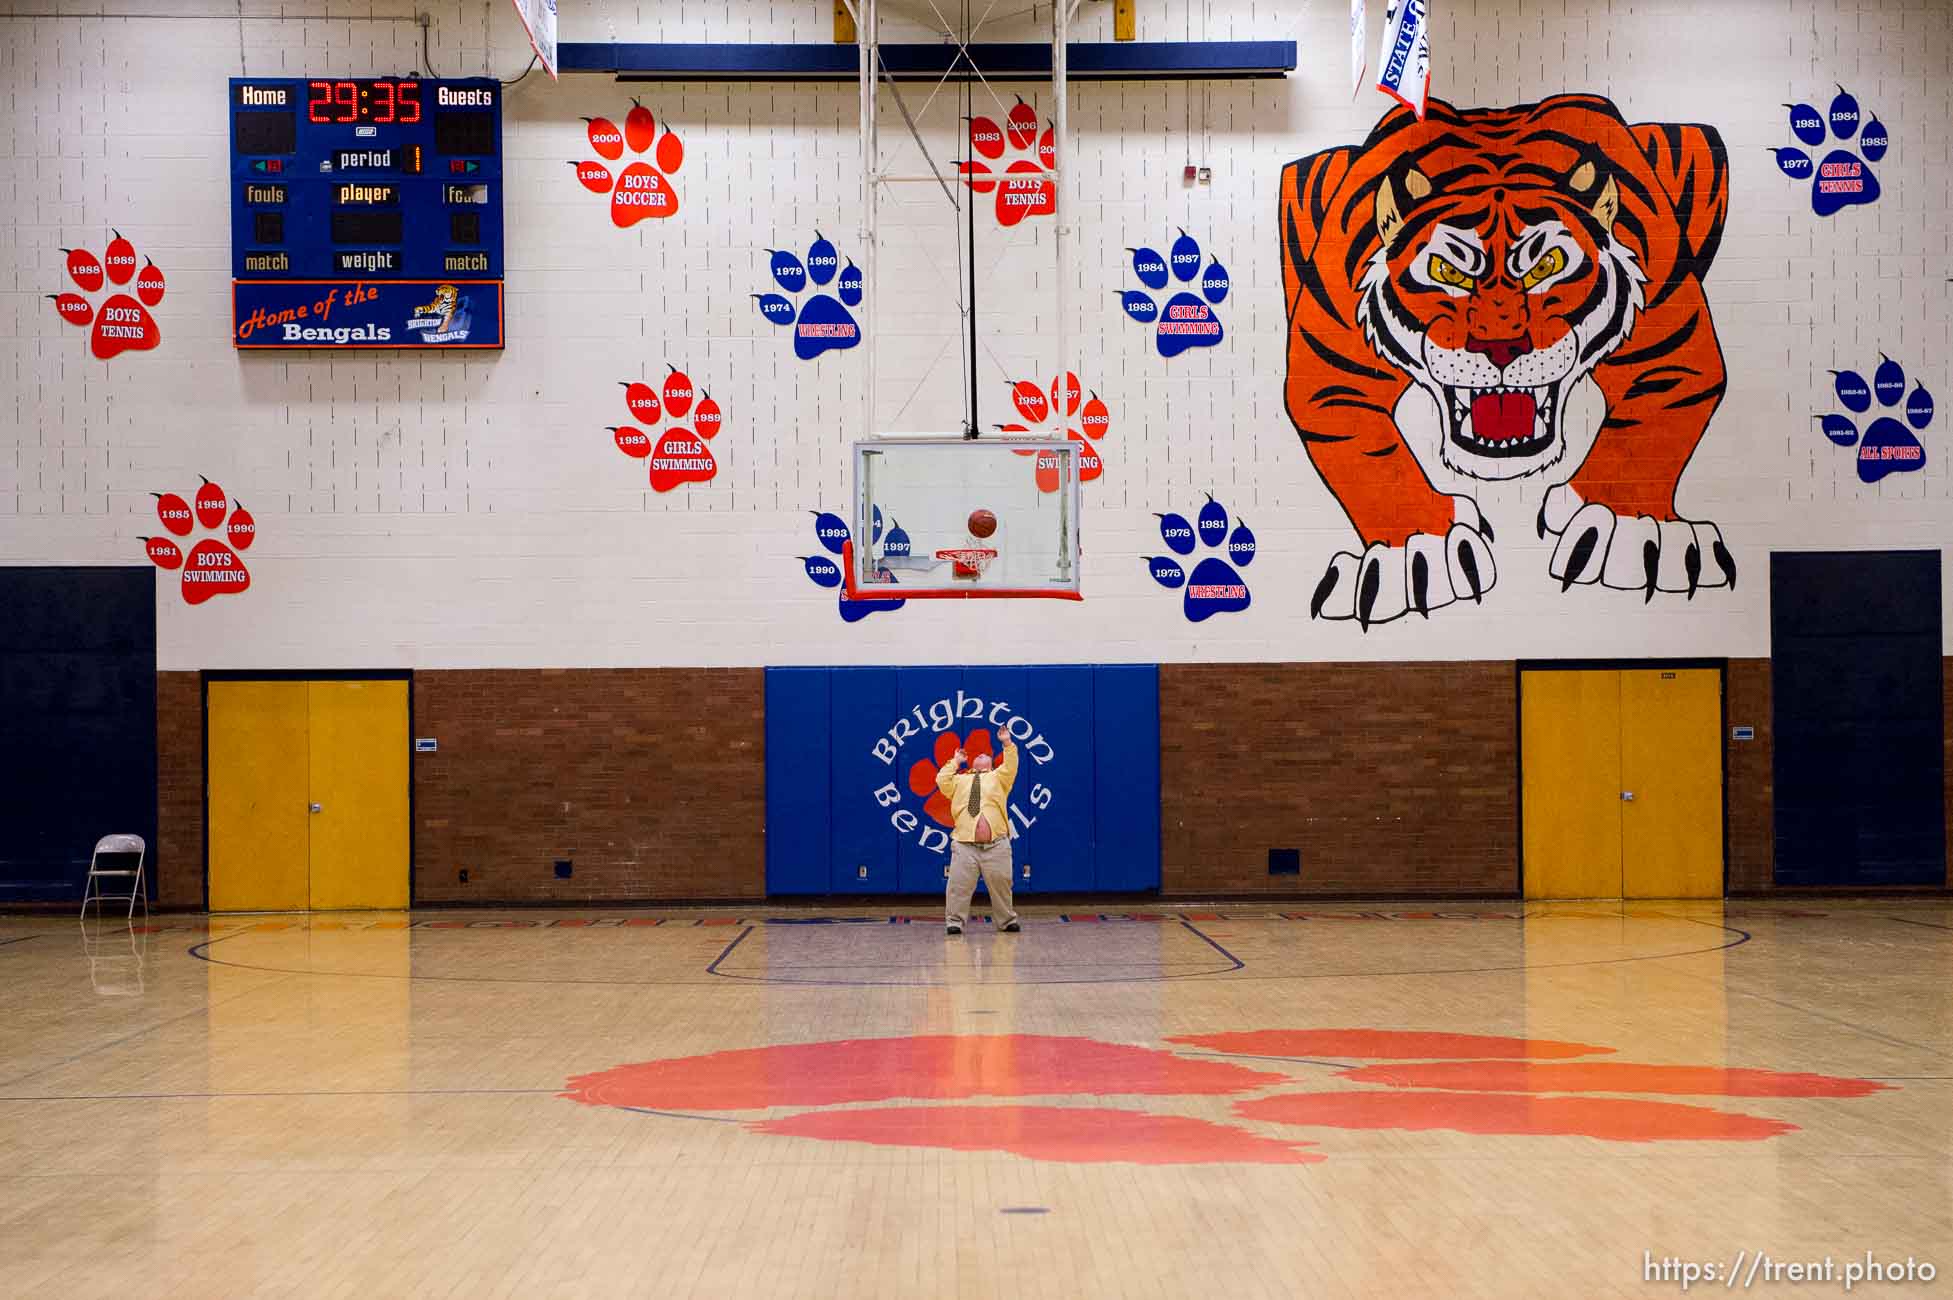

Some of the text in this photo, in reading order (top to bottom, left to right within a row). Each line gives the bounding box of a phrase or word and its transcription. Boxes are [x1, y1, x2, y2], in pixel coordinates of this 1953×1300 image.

[1386, 21, 1416, 87] STATE
[242, 86, 286, 105] Home
[438, 87, 492, 106] Guests
[309, 82, 420, 123] 29:35
[1832, 112, 1858, 120] 1984
[1008, 122, 1036, 130] 2006
[1796, 120, 1820, 128] 1981
[593, 134, 620, 142] 2000
[975, 133, 999, 141] 1983
[1861, 138, 1888, 146] 1985
[340, 149, 391, 169] period
[1783, 160, 1808, 169] 1977
[1821, 163, 1861, 177] GIRLS
[581, 171, 608, 179] 1989
[624, 176, 658, 188] BOYS
[1820, 180, 1863, 193] TENNIS
[248, 186, 284, 203] fouls
[340, 184, 391, 204] player
[616, 192, 666, 205] SOCCER
[1005, 193, 1046, 205] TENNIS
[107, 257, 134, 265] 1989
[246, 253, 289, 271] match
[342, 251, 393, 271] weight
[445, 254, 488, 271] match
[809, 257, 836, 265] 1980
[1173, 255, 1199, 263] 1987
[72, 265, 100, 274] 1988
[777, 267, 802, 276] 1979
[1138, 264, 1164, 272] 1984
[138, 280, 164, 289] 2008
[1203, 280, 1228, 289] 1988
[61, 303, 87, 311] 1980
[239, 281, 379, 339] Home of the
[764, 304, 790, 313] 1974
[1128, 303, 1154, 312] 1983
[106, 308, 140, 322] BOYS
[1170, 306, 1208, 319] GIRLS
[102, 325, 144, 339] TENNIS
[798, 324, 855, 337] WRESTLING
[1159, 322, 1219, 335] SWIMMING
[282, 323, 391, 344] Bengals
[665, 389, 692, 397] 1986
[1053, 390, 1079, 399] 187
[632, 400, 658, 408] 1985
[1018, 396, 1044, 405] 1984
[695, 414, 721, 422] 1989
[1083, 416, 1108, 424] 1988
[619, 436, 646, 445] 1982
[664, 441, 702, 454] GIRLS
[1861, 446, 1921, 460] ALL SPORTS
[653, 459, 712, 470] SWIMMING
[198, 500, 225, 509] 1986
[162, 510, 190, 518] 1985
[228, 524, 254, 533] 1990
[1201, 520, 1224, 529] 1981
[820, 529, 847, 537] 1993
[1165, 529, 1190, 537] 1978
[884, 543, 910, 551] 1997
[1229, 543, 1255, 551] 1982
[197, 553, 231, 566] BOYS
[809, 566, 835, 574] 1990
[1155, 569, 1180, 578] 1975
[184, 570, 245, 582] SWIMMING
[1189, 585, 1246, 598] WRESTLING
[874, 782, 1053, 854] Benls
